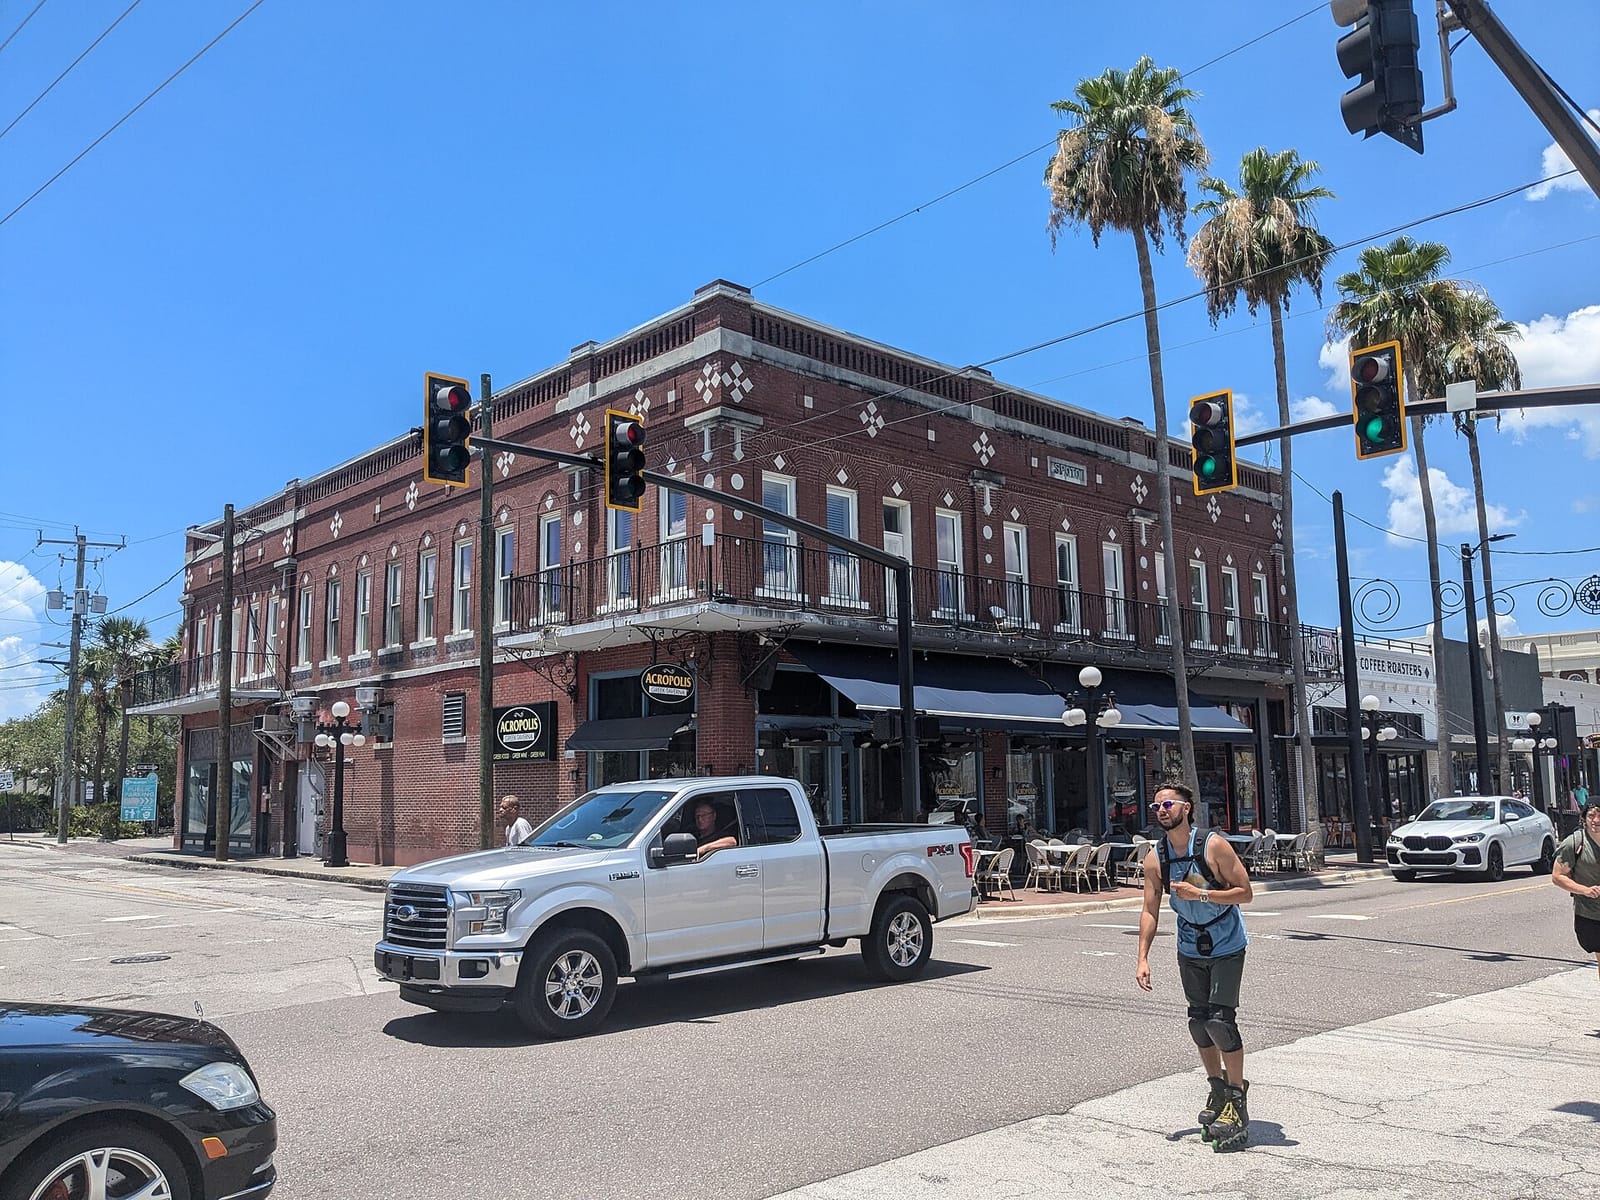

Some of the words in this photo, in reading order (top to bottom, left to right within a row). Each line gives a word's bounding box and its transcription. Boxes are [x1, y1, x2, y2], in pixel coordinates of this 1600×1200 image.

[1054, 463, 1080, 479] SPOTO
[1360, 657, 1386, 672] COFFEE
[1388, 661, 1422, 677] ROASTERS
[645, 672, 692, 688] ACROPOLIS
[500, 717, 539, 733] ACROPOLIS
[0, 782, 12, 790] 25
[927, 844, 954, 857] FX4
